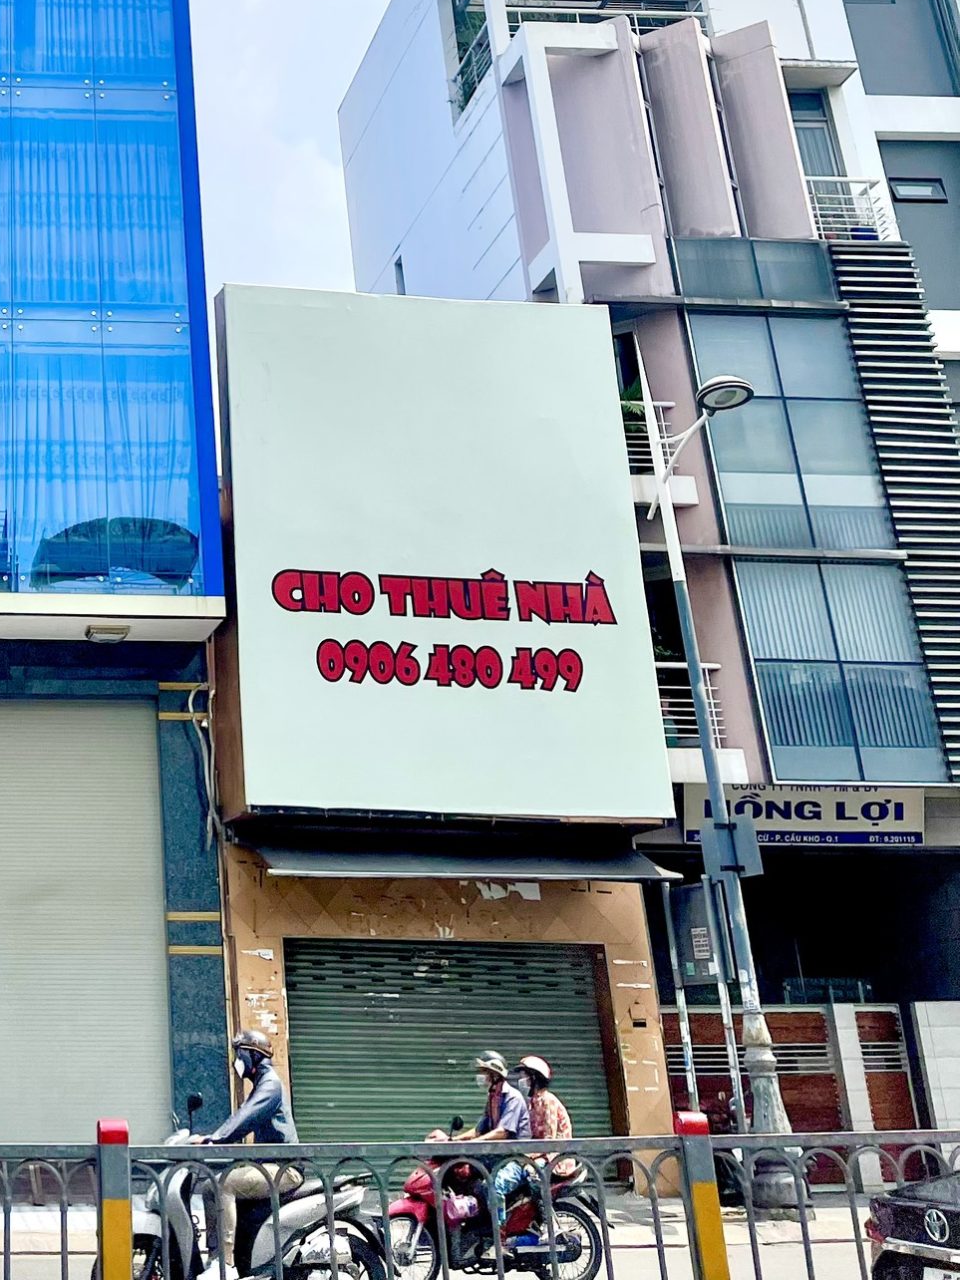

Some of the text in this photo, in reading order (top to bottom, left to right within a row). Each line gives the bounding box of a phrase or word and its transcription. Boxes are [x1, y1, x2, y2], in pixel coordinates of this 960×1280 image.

[272, 567, 618, 627] CHO THUÊ NHÀ
[316, 637, 584, 693] 0906 480 499
[835, 799, 904, 826] LỢI
